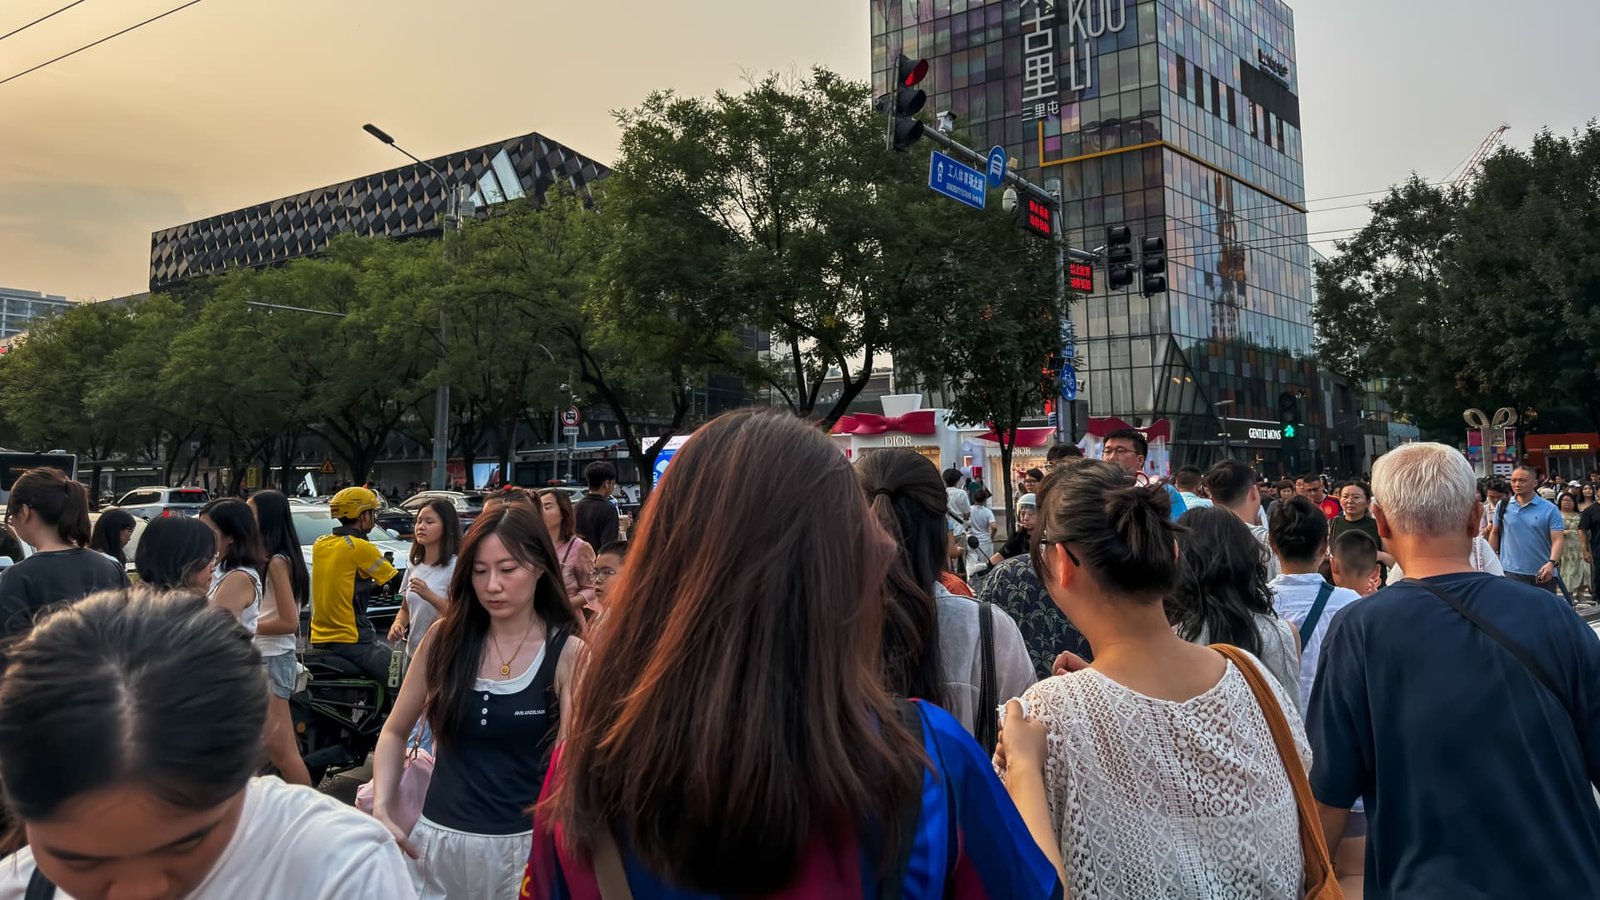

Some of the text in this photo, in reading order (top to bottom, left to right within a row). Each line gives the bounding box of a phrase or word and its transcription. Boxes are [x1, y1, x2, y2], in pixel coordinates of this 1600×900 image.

[1069, 42, 1092, 91] LI
[1021, 100, 1059, 121] 三里屯
[883, 435, 913, 447] DIOR
[1248, 427, 1282, 440] GENTLE MONS
